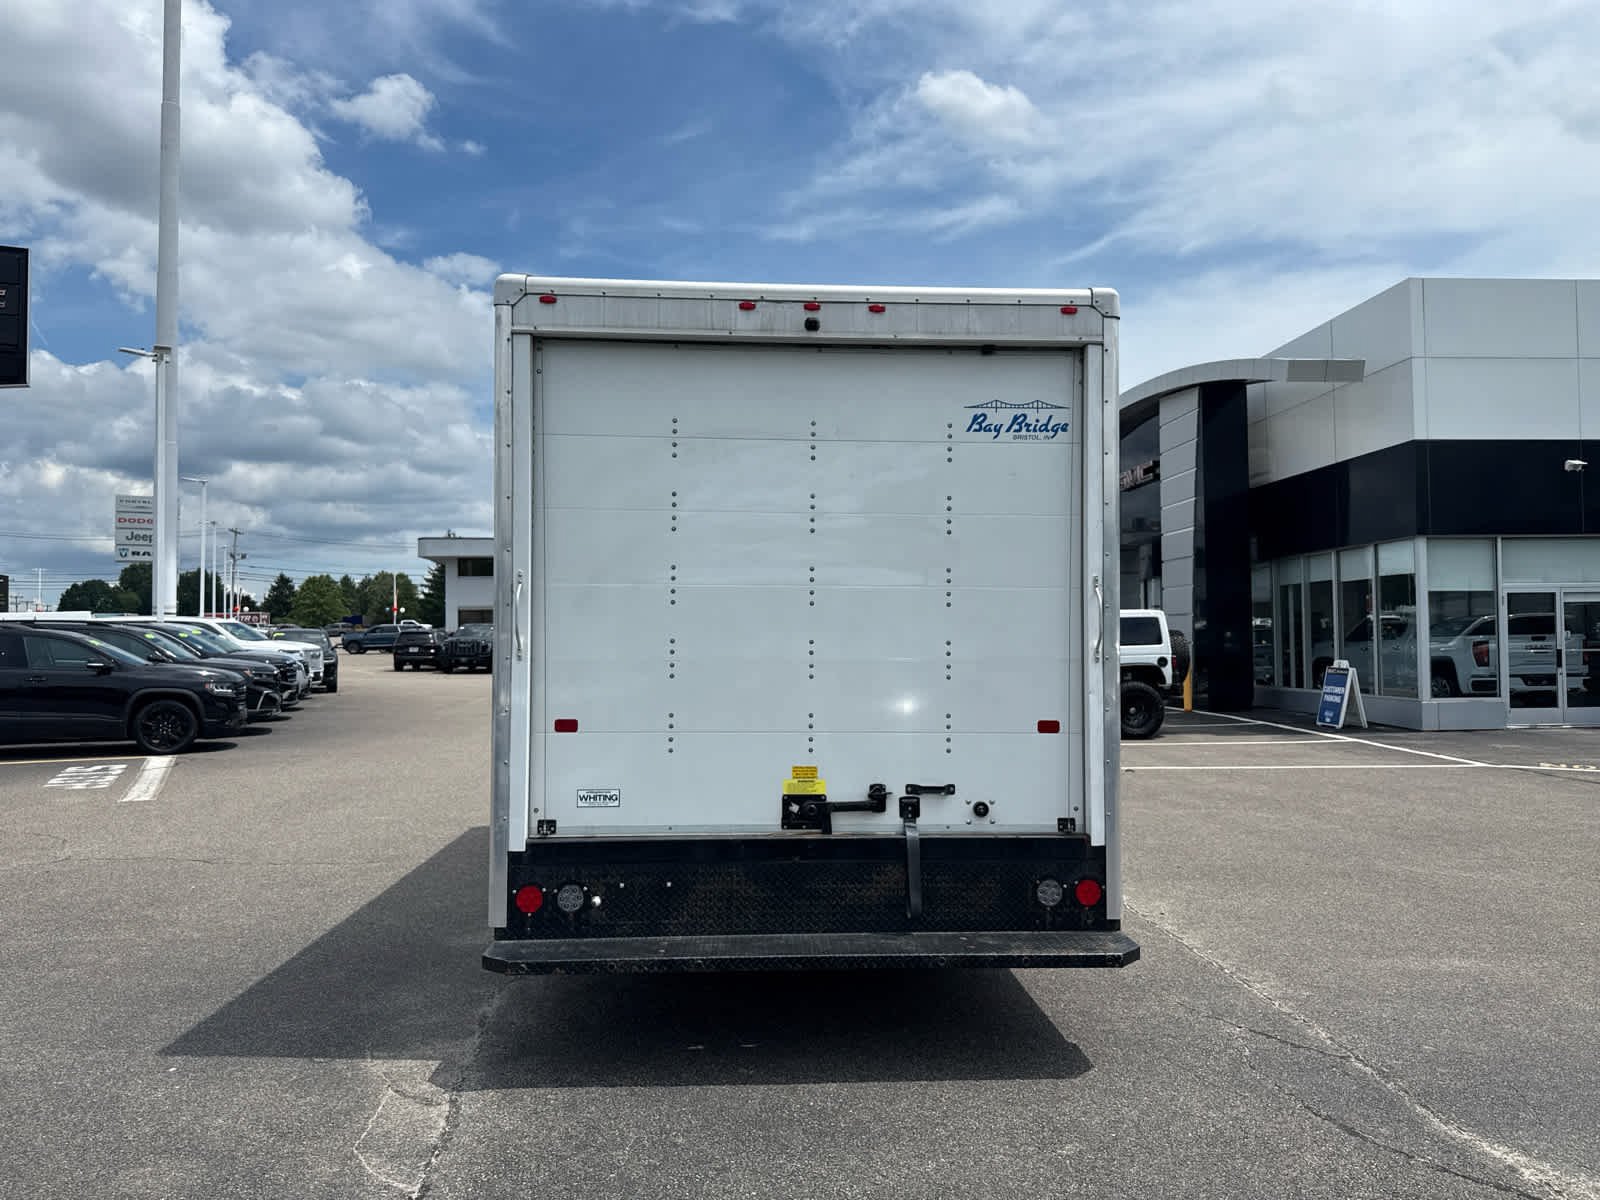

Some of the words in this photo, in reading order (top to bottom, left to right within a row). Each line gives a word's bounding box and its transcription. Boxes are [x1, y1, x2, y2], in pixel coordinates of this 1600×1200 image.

[965, 412, 1004, 440] Bay
[1005, 412, 1070, 439] Bridge
[578, 793, 618, 802] WHITING
